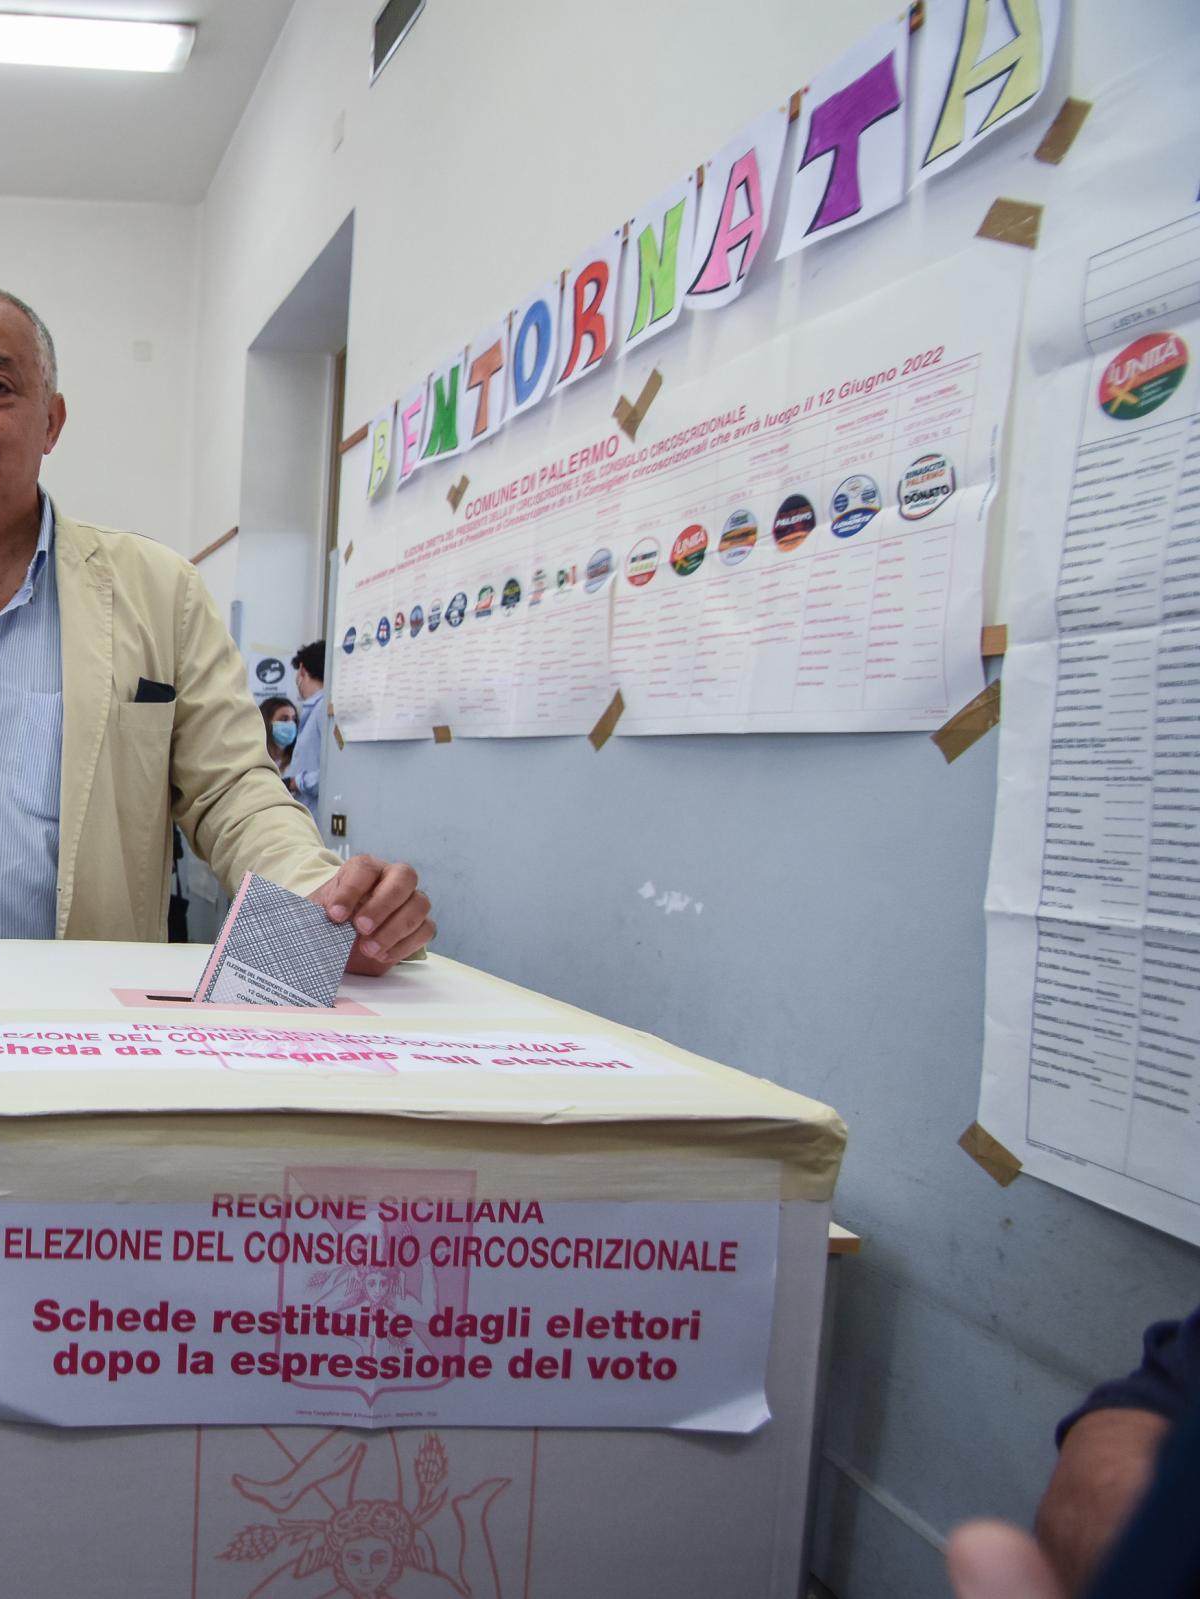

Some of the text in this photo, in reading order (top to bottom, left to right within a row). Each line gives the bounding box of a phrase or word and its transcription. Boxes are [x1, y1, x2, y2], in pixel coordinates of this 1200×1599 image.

[368, 0, 1042, 499] BENTORNATA
[632, 440, 709, 479] circoscrizionali
[710, 432, 731, 449] che
[733, 417, 760, 440] avrà
[763, 403, 800, 428] luogo
[803, 396, 815, 413] il
[818, 388, 836, 407] 12
[838, 367, 898, 400] Giugno
[900, 345, 945, 376] 2022
[599, 448, 650, 478] CONSIGLIO
[650, 404, 747, 459] CIRCOSCRIZIONALE
[464, 434, 620, 520] COMUNE DI PALERMO
[904, 485, 950, 505] DONATO
[255, 992, 278, 1006] GIUGNO
[256, 977, 283, 992] PRESIDENTE
[107, 1032, 163, 1043] DEL
[167, 1031, 315, 1043] CONSIGLIO
[114, 1045, 163, 1057] da
[174, 1048, 399, 1063] consegnare
[412, 1052, 484, 1066] agli
[490, 1056, 635, 1070] elettori
[211, 1192, 545, 1225] REGIONE SICILIANA
[4, 1227, 739, 1273] ELEZIONE DEL CONSIGLIO CIRCOSCRIZIONALE
[32, 1298, 702, 1346] Schede restituite dagli elettori
[52, 1342, 678, 1383] dopo la espressione del voto
